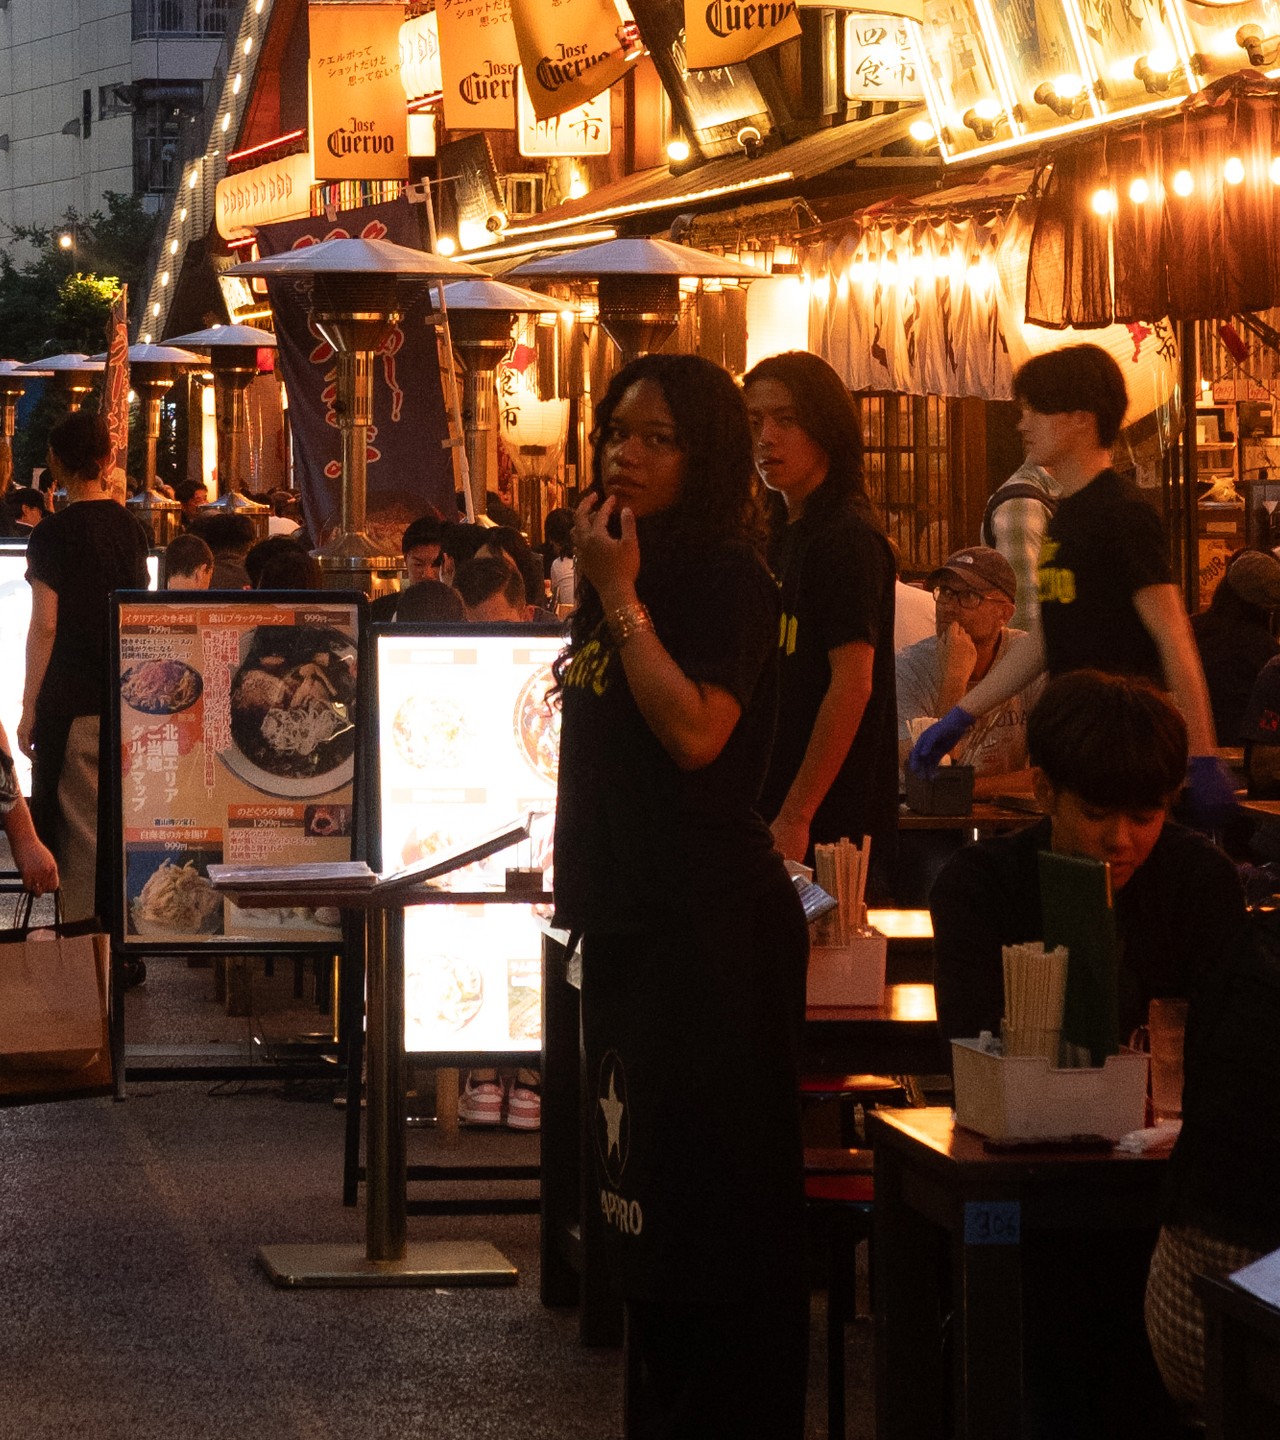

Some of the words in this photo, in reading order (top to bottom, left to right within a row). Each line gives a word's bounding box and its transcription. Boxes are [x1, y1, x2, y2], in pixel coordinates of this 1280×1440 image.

[317, 46, 373, 69] クエルボって
[555, 43, 589, 62] Jose
[327, 55, 387, 78] ショットだけと
[483, 60, 514, 79] Jose
[349, 117, 376, 135] Jose
[327, 127, 394, 158] Cuervo
